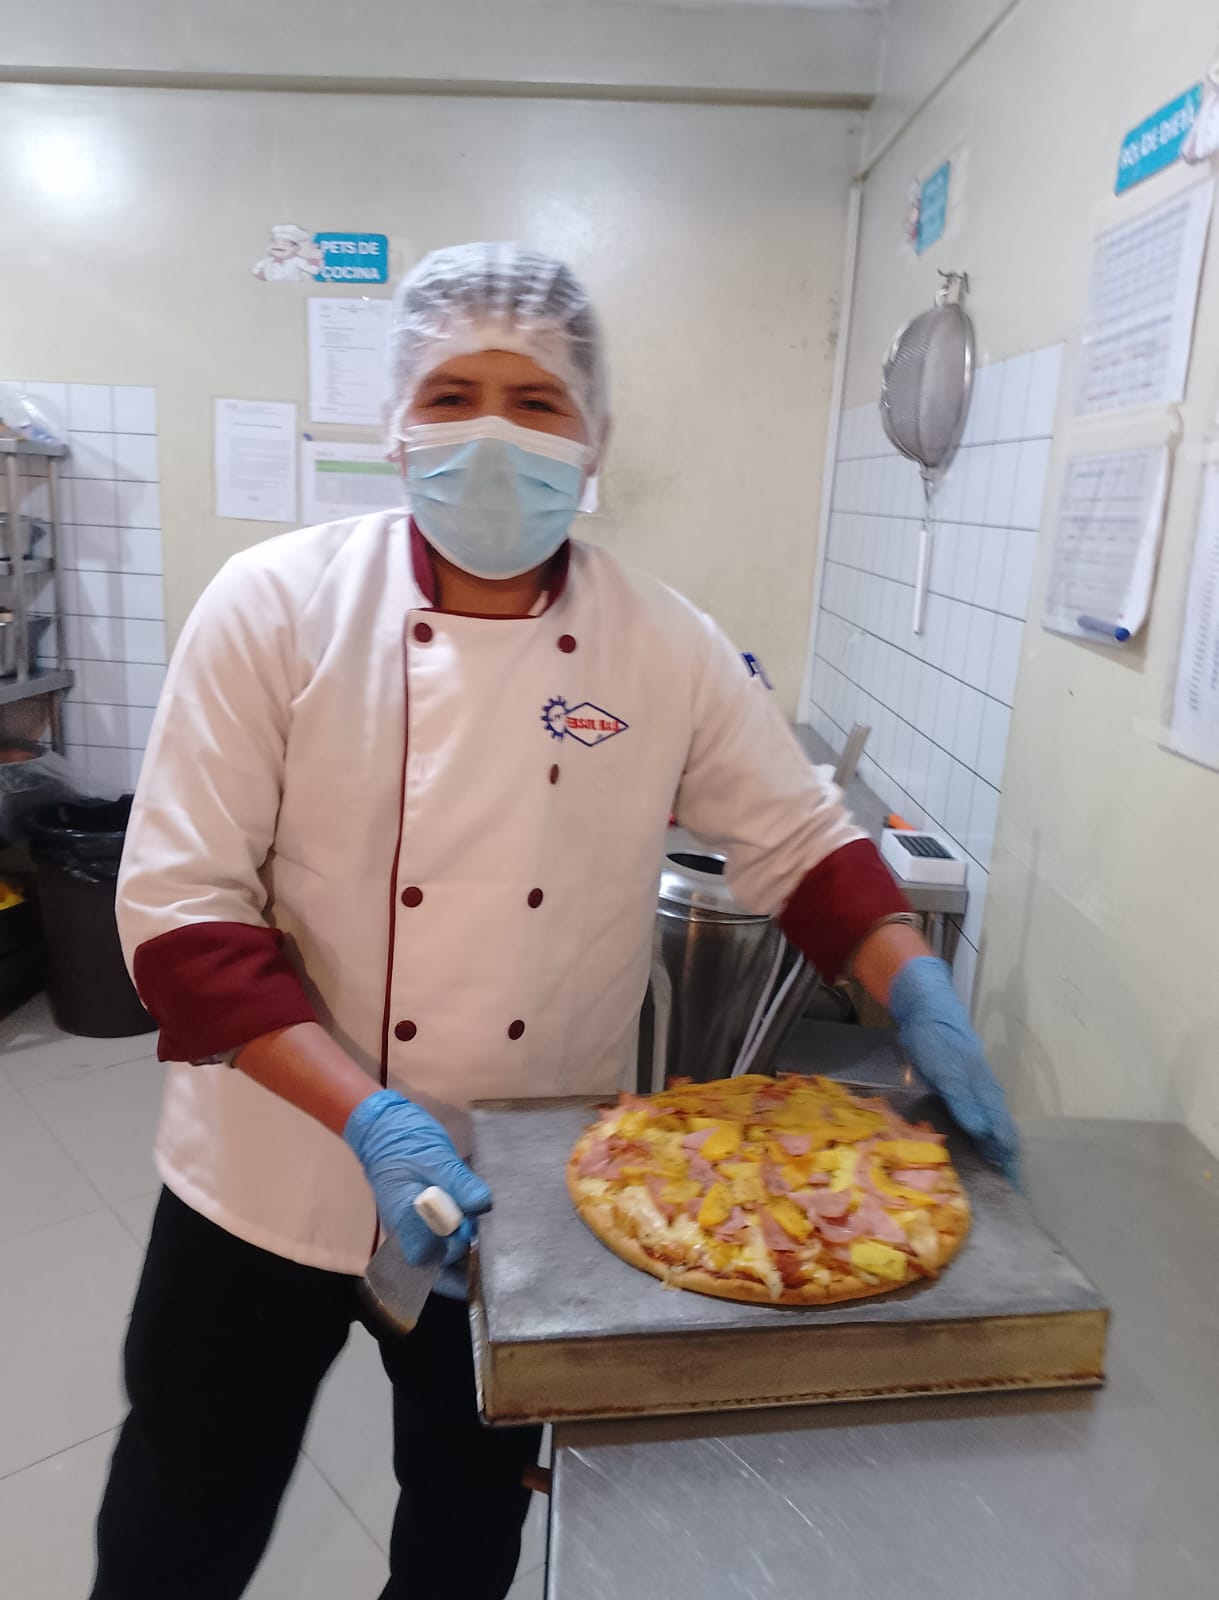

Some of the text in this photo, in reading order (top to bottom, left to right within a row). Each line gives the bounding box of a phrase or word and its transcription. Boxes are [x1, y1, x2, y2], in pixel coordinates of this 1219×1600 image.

[320, 240, 380, 255] PETS DE
[320, 265, 380, 280] COCINA
